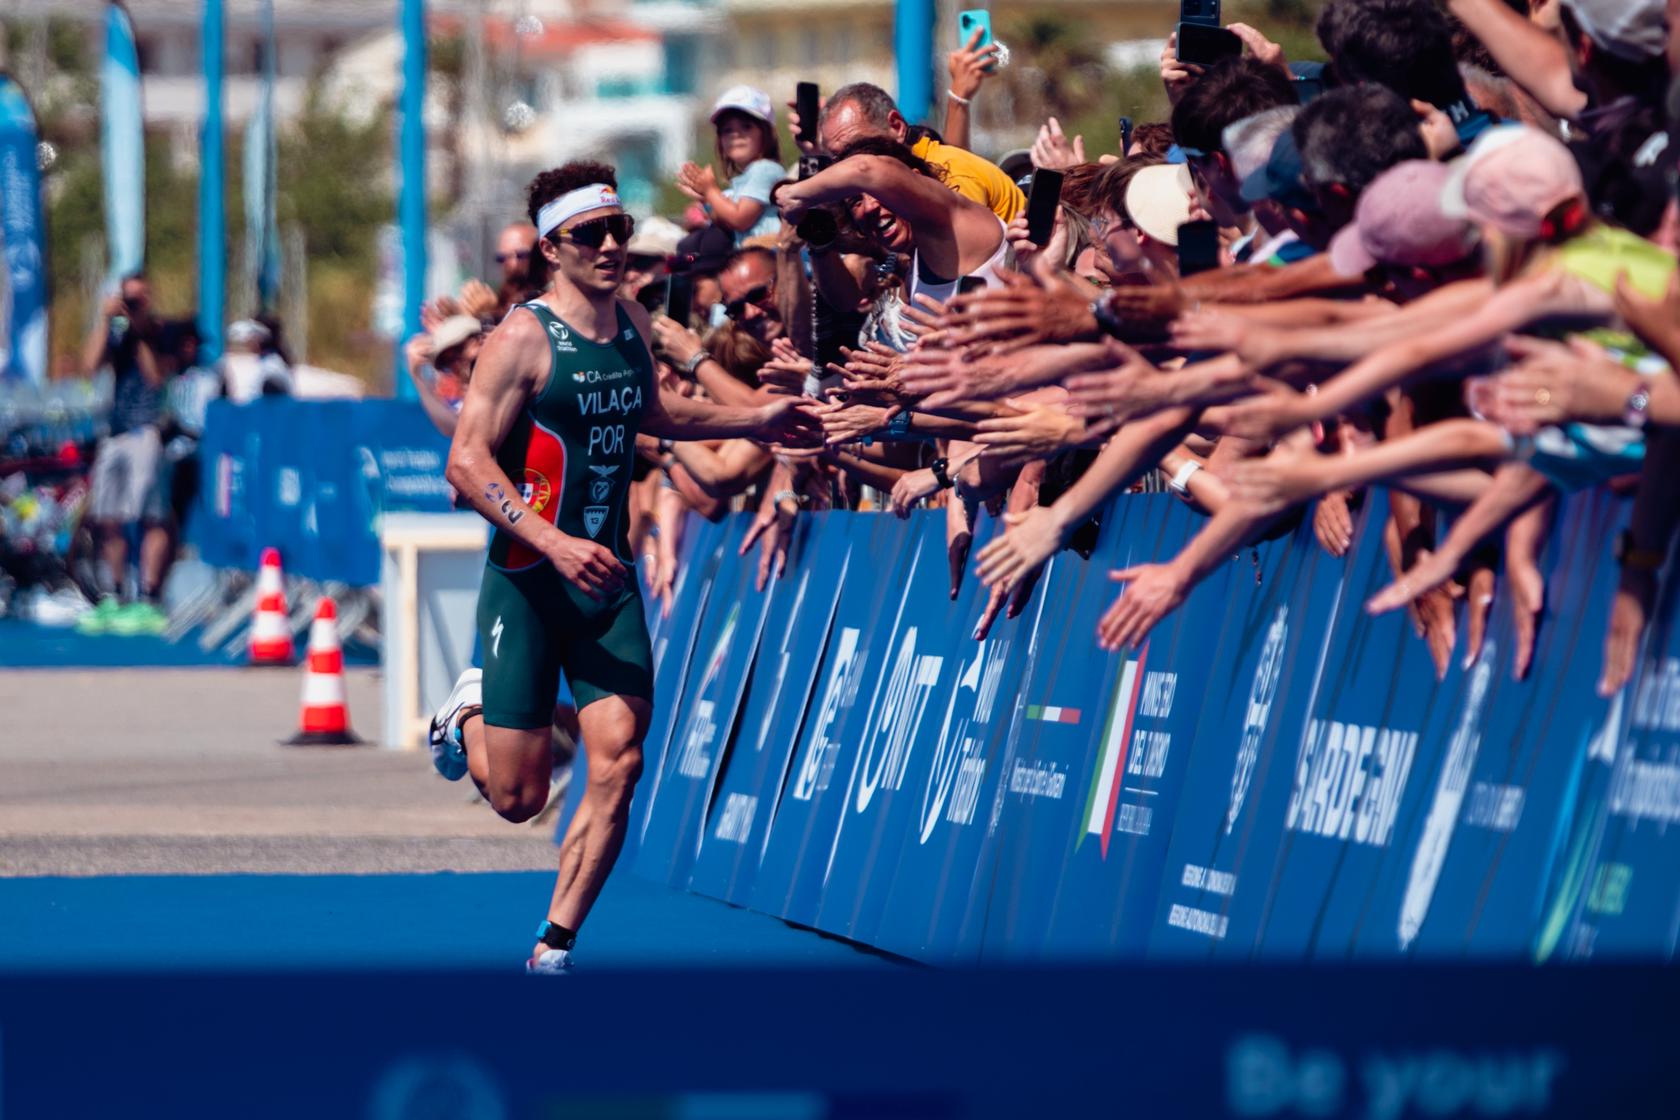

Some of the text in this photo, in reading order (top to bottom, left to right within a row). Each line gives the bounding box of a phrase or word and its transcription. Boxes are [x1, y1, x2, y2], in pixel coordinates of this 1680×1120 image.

[587, 370, 602, 384] CA
[577, 385, 642, 416] VILAÇA
[587, 424, 625, 456] POR
[1287, 718, 1419, 848] SARDEGNA
[1230, 1036, 1560, 1120] Be your
